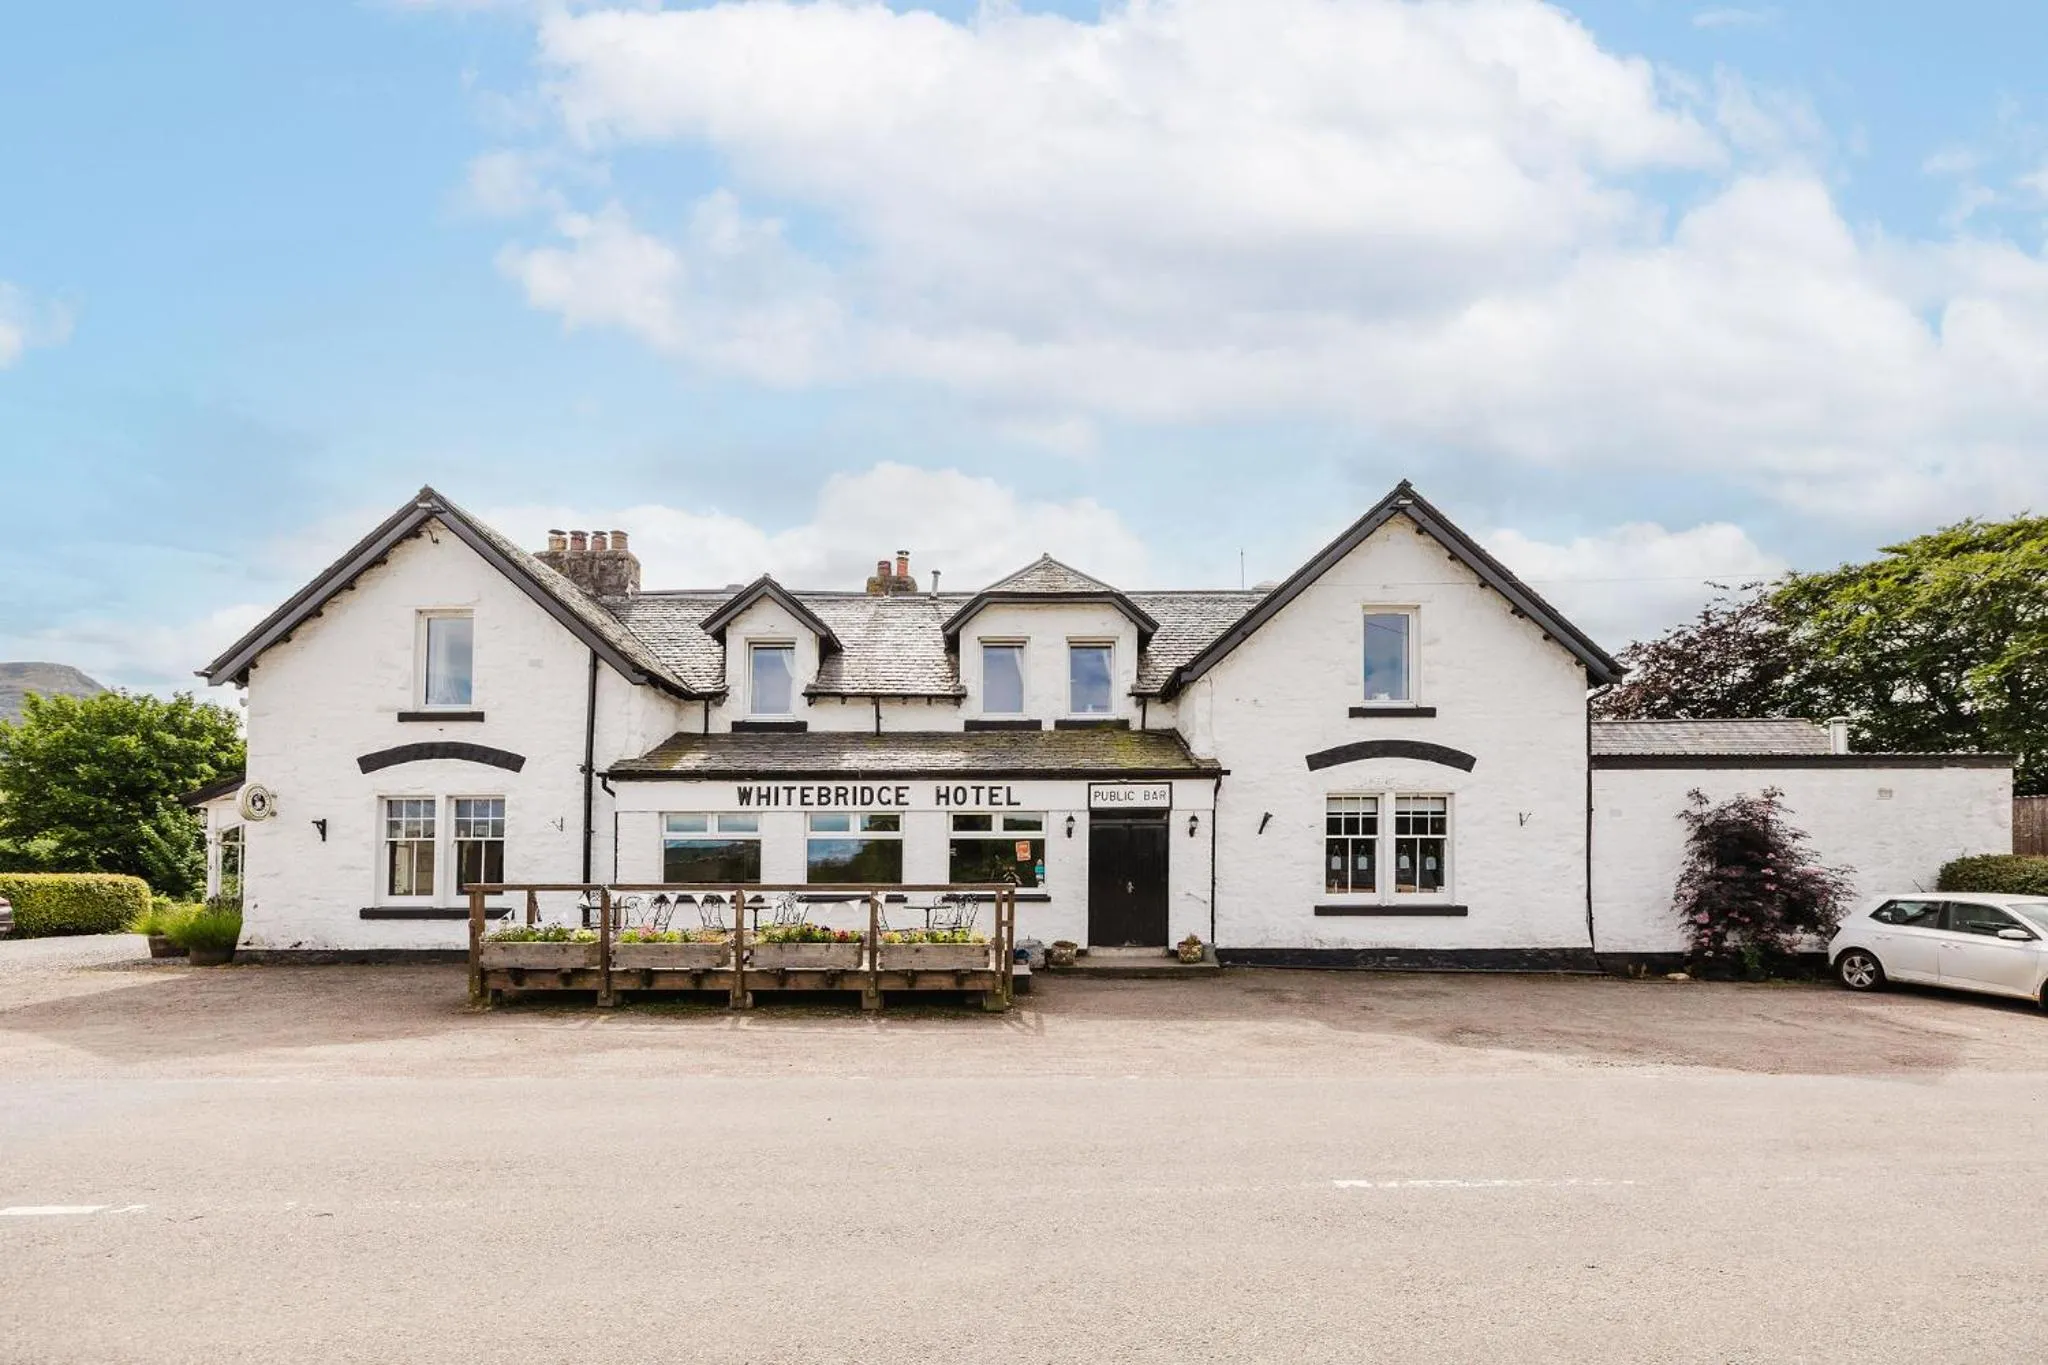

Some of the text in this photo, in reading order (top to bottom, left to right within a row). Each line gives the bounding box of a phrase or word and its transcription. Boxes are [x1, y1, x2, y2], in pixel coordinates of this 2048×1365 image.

[737, 786, 1021, 806] WHITEBRIDGE HOTEL
[1093, 791, 1167, 802] PUBLIC BAR
